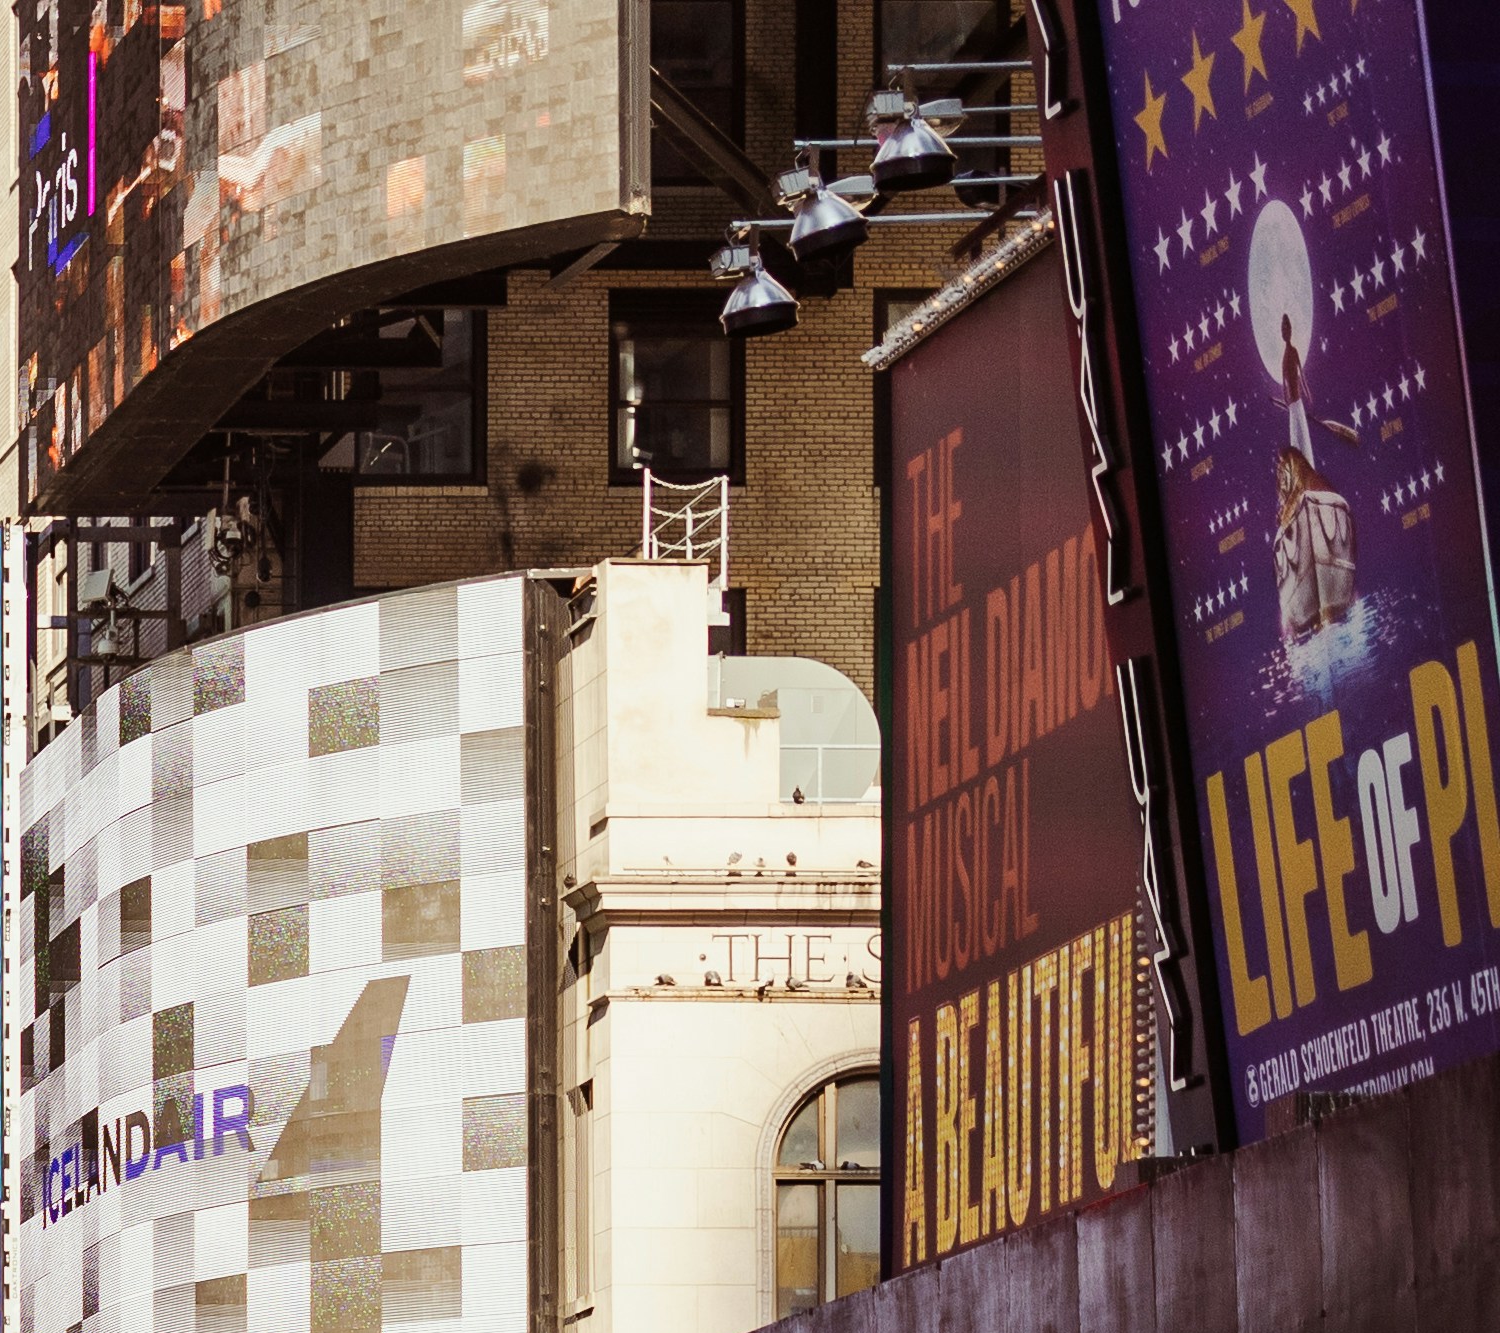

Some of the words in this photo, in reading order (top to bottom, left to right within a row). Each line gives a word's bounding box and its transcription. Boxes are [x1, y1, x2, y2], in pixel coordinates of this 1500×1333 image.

[907, 426, 962, 627] THE
[907, 607, 979, 812] NEIL
[905, 755, 1039, 995] MUSICAL
[1206, 708, 1372, 1036] LIFE
[1356, 732, 1420, 934] OF
[1409, 640, 1500, 949] PI
[713, 933, 834, 985] THE
[1259, 1048, 1299, 1102] GERALD
[1300, 1019, 1370, 1084] SCHOENFELD
[1371, 997, 1427, 1055] THEATRE,
[1426, 986, 1451, 1034] 236
[1452, 980, 1468, 1025] W.
[41, 1084, 255, 1232] ICELANDAIR
[903, 1016, 927, 1268] A
